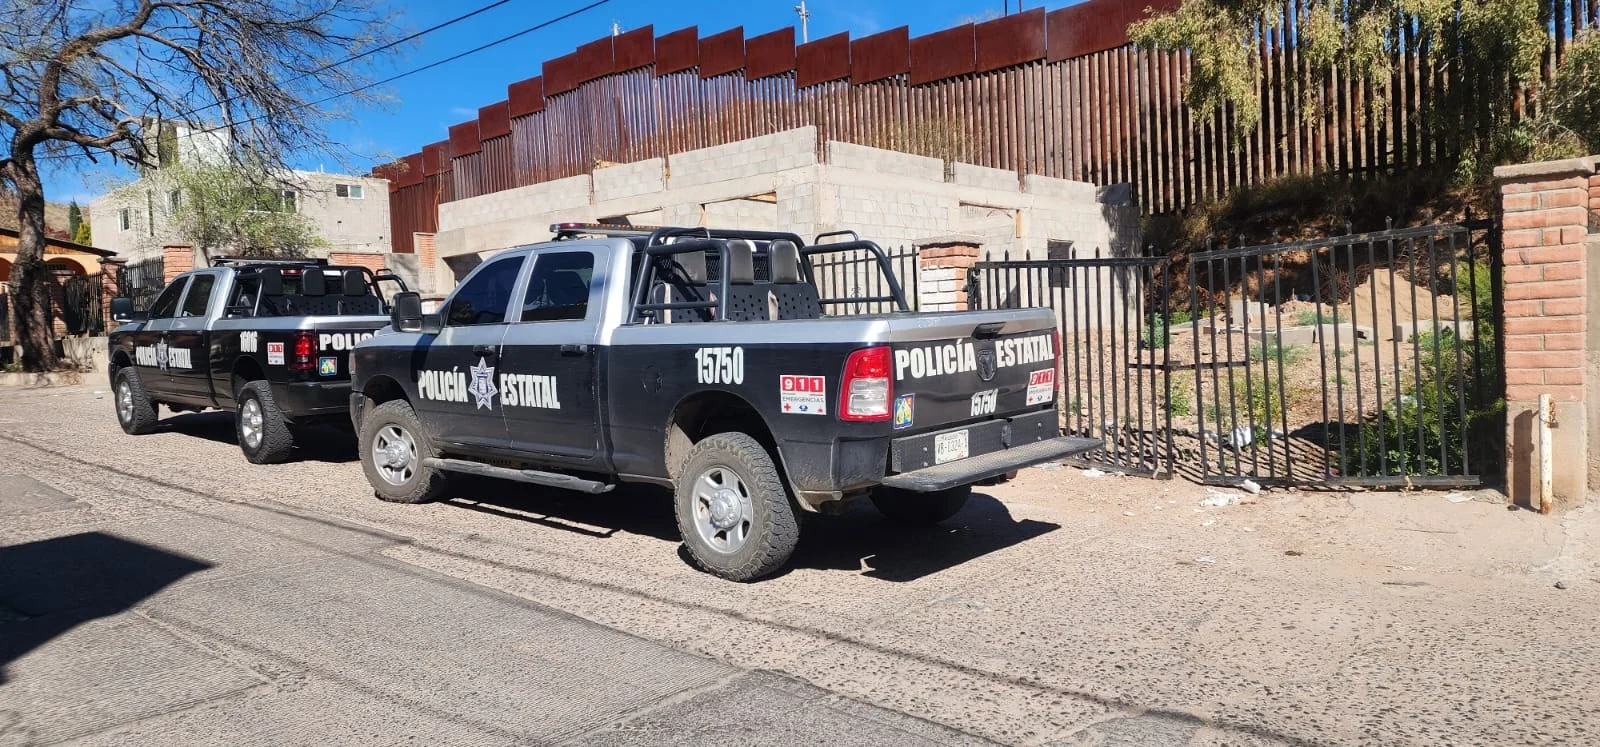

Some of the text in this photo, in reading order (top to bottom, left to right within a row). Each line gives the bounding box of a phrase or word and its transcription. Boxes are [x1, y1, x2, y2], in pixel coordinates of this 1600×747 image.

[168, 347, 192, 369] ESTATAL
[695, 346, 744, 385] 15750
[895, 334, 1054, 380] POLICÍA ESTATAL
[417, 365, 561, 410] POLICÍA ESTATAL
[783, 377, 821, 391] 911
[970, 388, 999, 417] 15750
